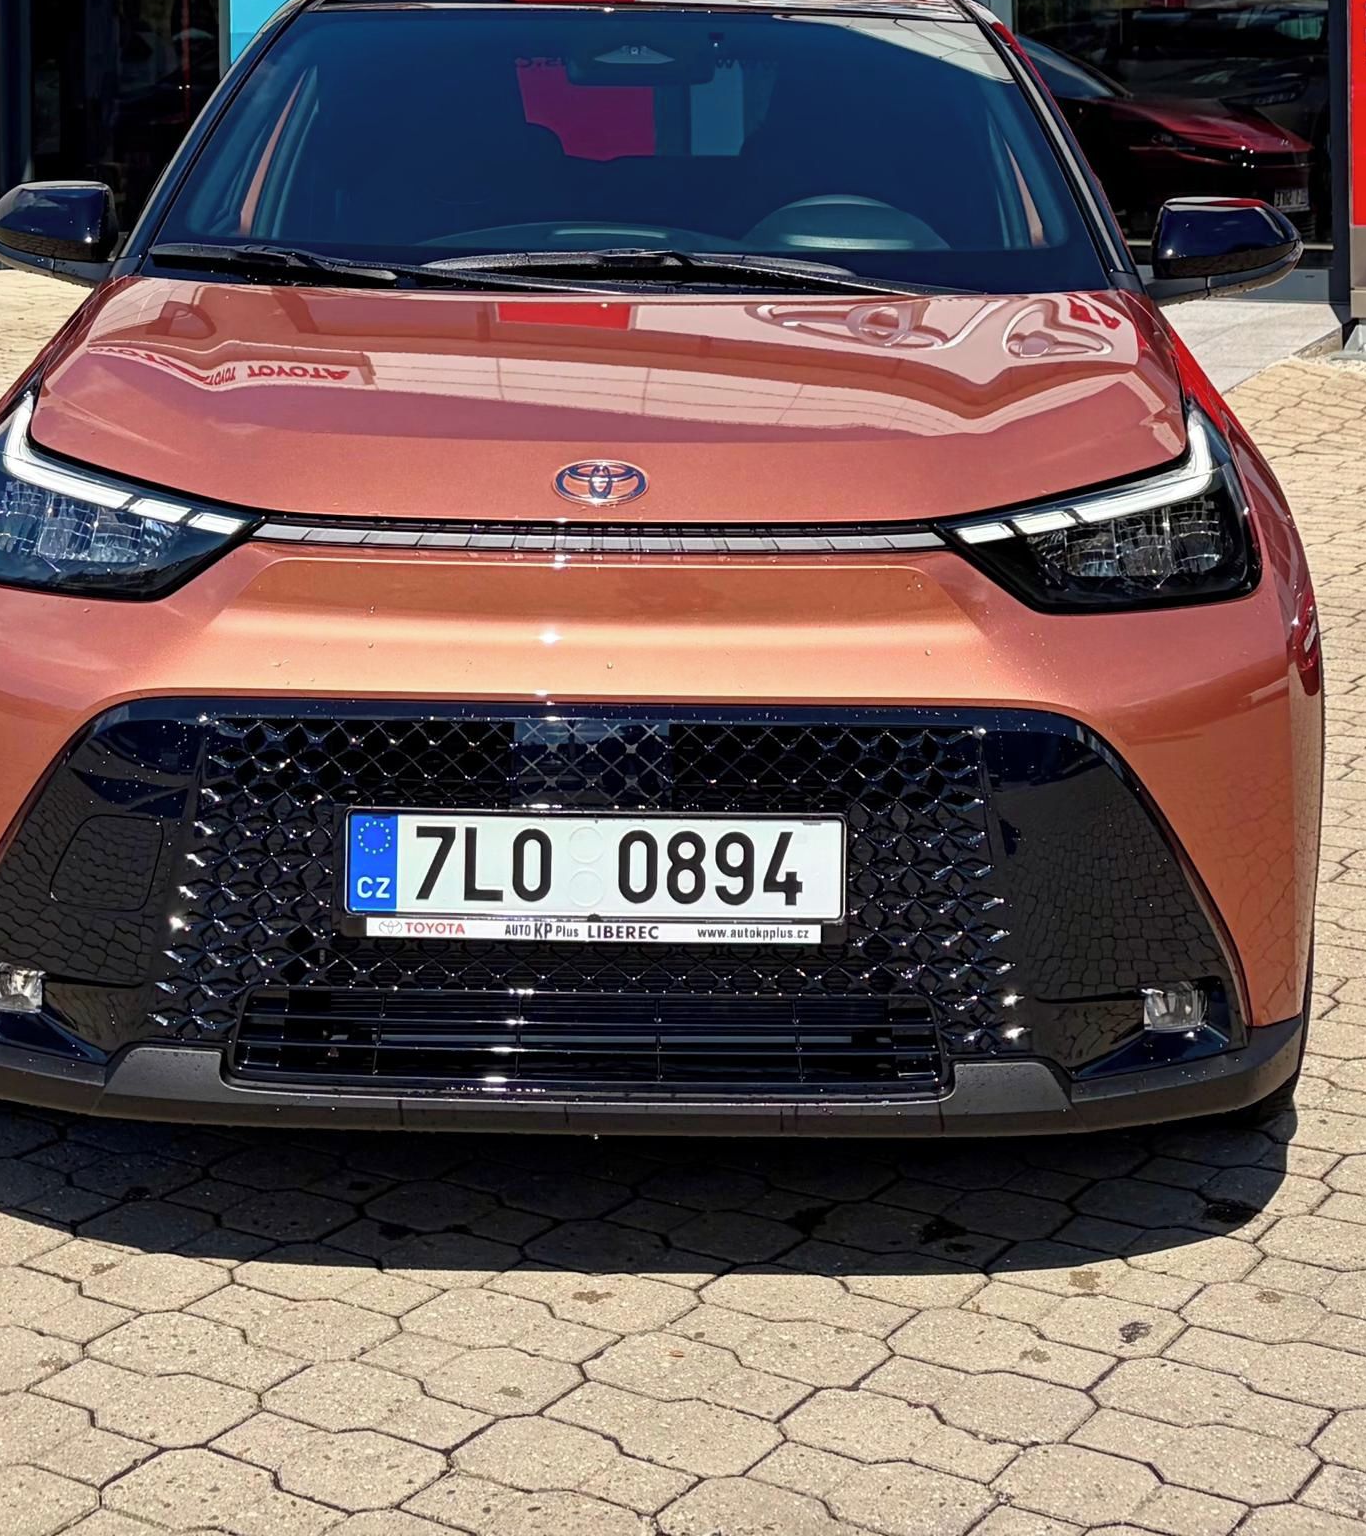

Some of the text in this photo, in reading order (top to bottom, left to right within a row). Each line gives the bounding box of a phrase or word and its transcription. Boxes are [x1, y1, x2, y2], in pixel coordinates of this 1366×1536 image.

[618, 829, 804, 906] 0894
[356, 876, 390, 900] CZ
[405, 921, 810, 941] TOYOTA AUTO KP Plus LIBEREC www.autokpplus.cz
